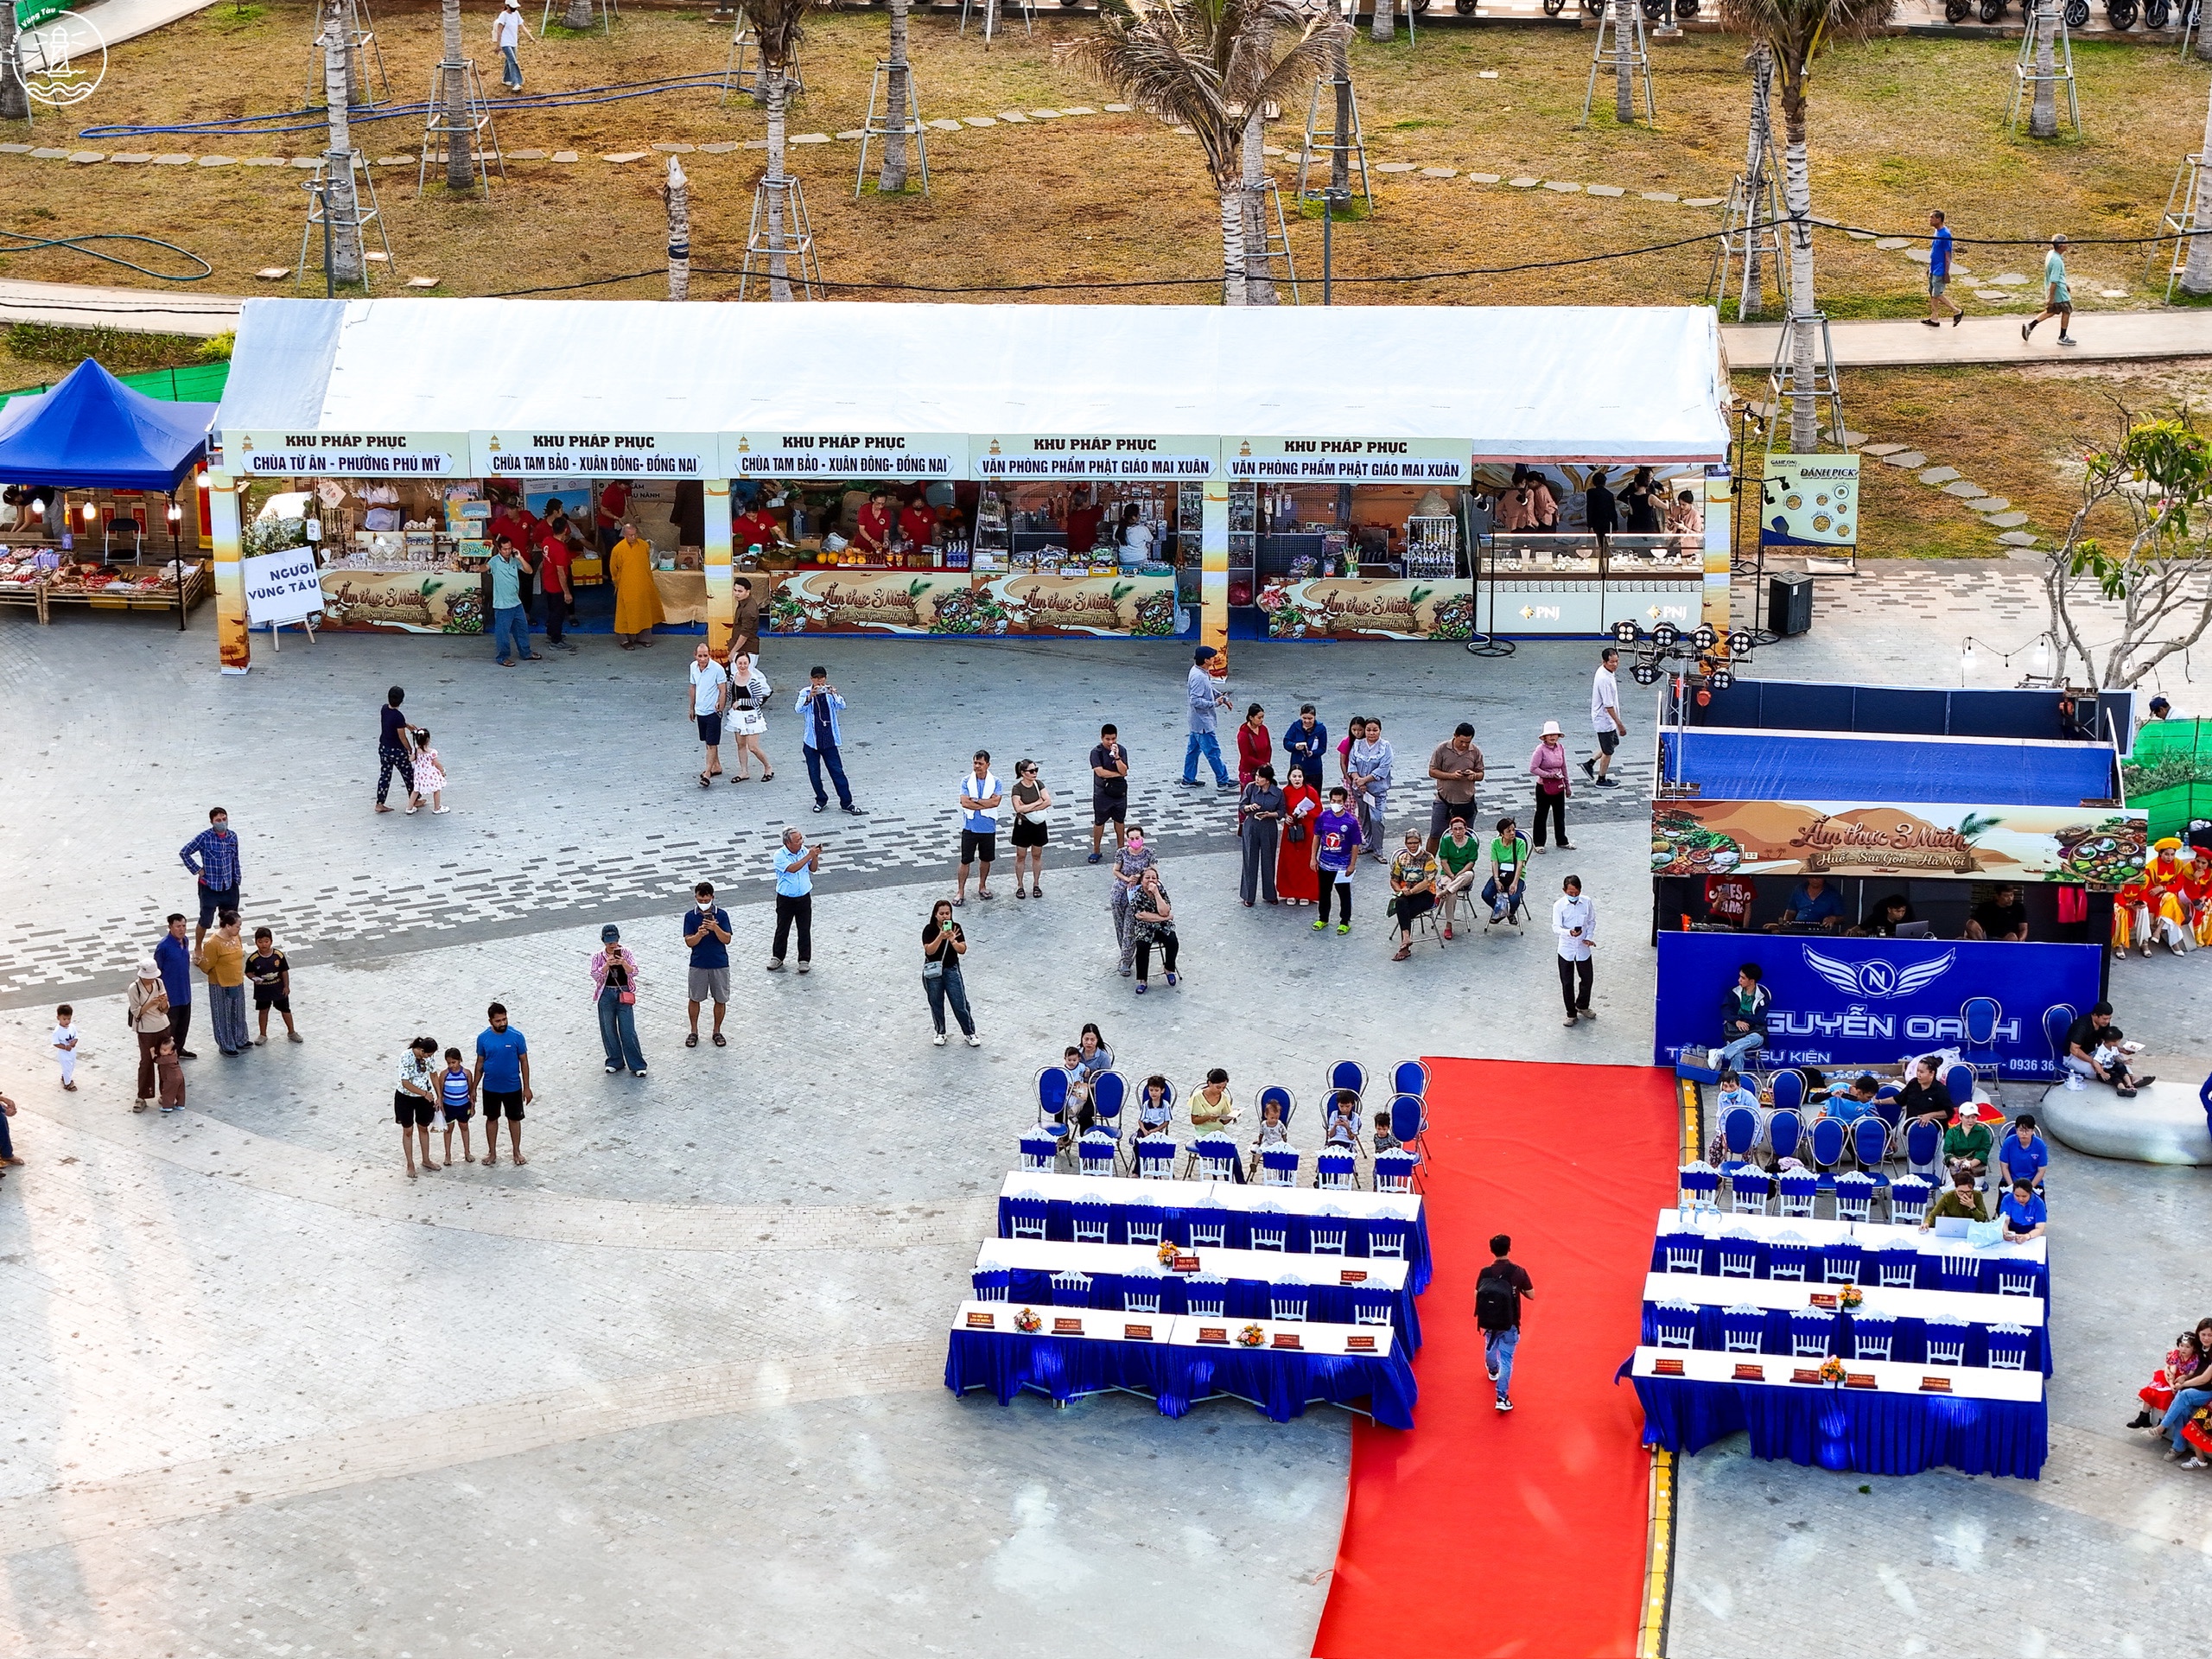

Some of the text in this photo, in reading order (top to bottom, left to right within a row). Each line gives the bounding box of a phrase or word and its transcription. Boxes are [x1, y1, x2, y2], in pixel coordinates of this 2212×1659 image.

[285, 434, 406, 450] KHU PHÁP PHỤC
[533, 434, 654, 450] KHU PHÁP PHỤC
[783, 435, 905, 450] KHU PHÁP PHỤC
[1034, 436, 1156, 453] KHU PHÁP PHỤC
[1285, 439, 1407, 455] KHU PHÁP PHỤC
[253, 454, 286, 470] CHÙA
[289, 454, 306, 470] TỪ
[309, 454, 326, 470] ÂN
[339, 454, 390, 471] PHƯỜNG
[393, 454, 418, 471] PHÚ
[422, 454, 442, 472] MỸ
[493, 454, 521, 470] CHÙA
[524, 456, 545, 470] TAM
[548, 452, 569, 471] BẢO
[579, 454, 607, 471] XUÂN
[646, 454, 675, 472] ĐỒNG
[678, 458, 696, 472] NAI
[741, 454, 770, 472] CHÙA
[772, 457, 794, 472] TAM
[798, 453, 818, 472] BẢO
[829, 454, 857, 472] XUÂN
[897, 454, 925, 473] ĐỒNG
[929, 458, 947, 473] NAI
[982, 455, 1209, 475] VĂN PHÒNG PHẨM PHẬT GIÁO MAI XUÂN
[1232, 457, 1459, 478] VĂN PHÒNG PHẨM PHẬT GIÁO MAI XUÂN
[1800, 467, 1858, 478] ĐÁNH PICK
[385, 588, 397, 607] 3
[871, 587, 885, 608] 3
[1073, 591, 1086, 612] 3
[1371, 595, 1384, 615] 3
[1536, 606, 1560, 620] PNJ
[1663, 606, 1687, 620] PNJ
[1789, 815, 1970, 852] Ẩm thực 3 Miền
[1816, 852, 1847, 867] Huế
[1857, 852, 1879, 864] Sài
[1883, 853, 1907, 867] Gòn
[1916, 855, 1940, 867] Hà
[1944, 855, 1966, 867] Nội
[1766, 1005, 2021, 1043] GUYỄN OAH
[1758, 1048, 1787, 1065] SỰ
[1789, 1049, 1832, 1065] KIỆN
[2009, 1058, 2037, 1071] 0936
